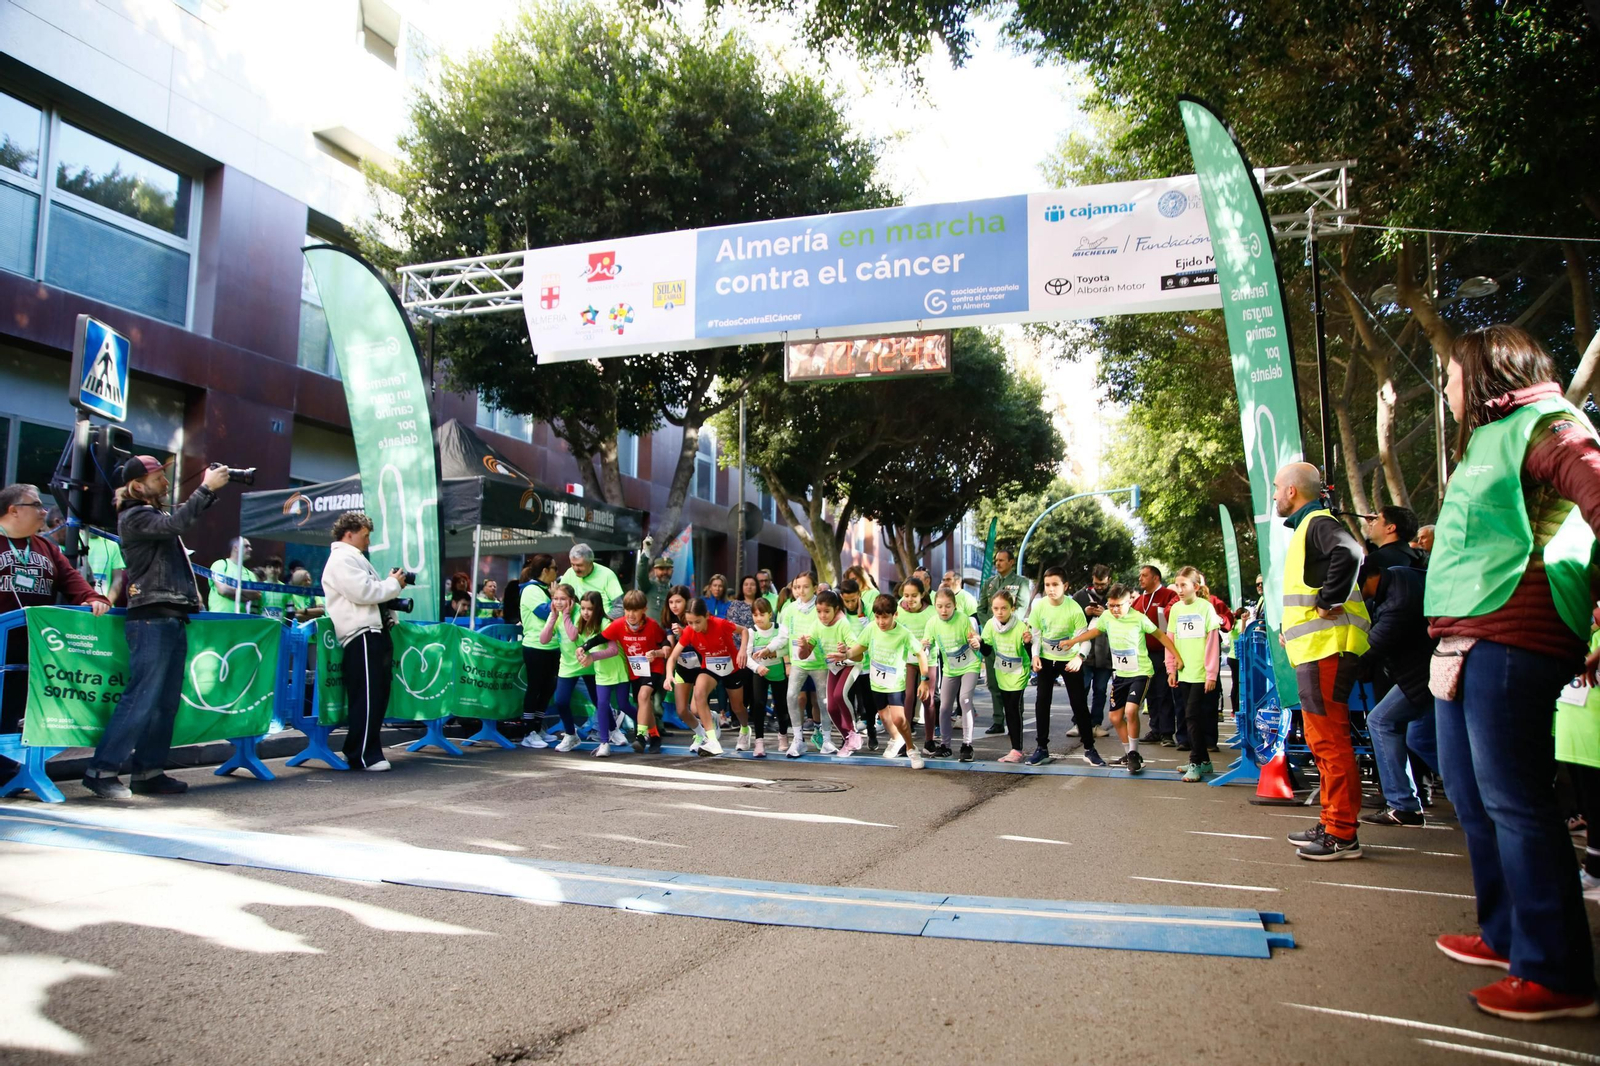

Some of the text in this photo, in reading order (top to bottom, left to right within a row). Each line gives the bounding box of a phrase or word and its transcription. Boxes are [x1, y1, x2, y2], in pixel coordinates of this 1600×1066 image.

[1070, 202, 1136, 220] cajamar
[716, 211, 1006, 262] Almería en marcha
[1136, 234, 1211, 252] Fundación
[1072, 249, 1118, 258] MICHELIN
[1176, 256, 1202, 270] Ejido
[716, 253, 964, 295] contra el cáncer
[1077, 275, 1110, 284] Toyota
[950, 284, 1020, 296] asociación española
[1077, 282, 1146, 295] Alborán Motor
[982, 292, 1005, 300] cáncer
[530, 314, 567, 326] ALMERÍA
[708, 314, 802, 328] #TodosContraElCáncer
[1182, 622, 1194, 630] 76
[66, 633, 98, 641] asociación
[956, 654, 967, 663] 73
[1116, 656, 1128, 664] 74
[43, 664, 125, 686] Contra el
[876, 669, 886, 679] 71
[44, 685, 96, 702] somos
